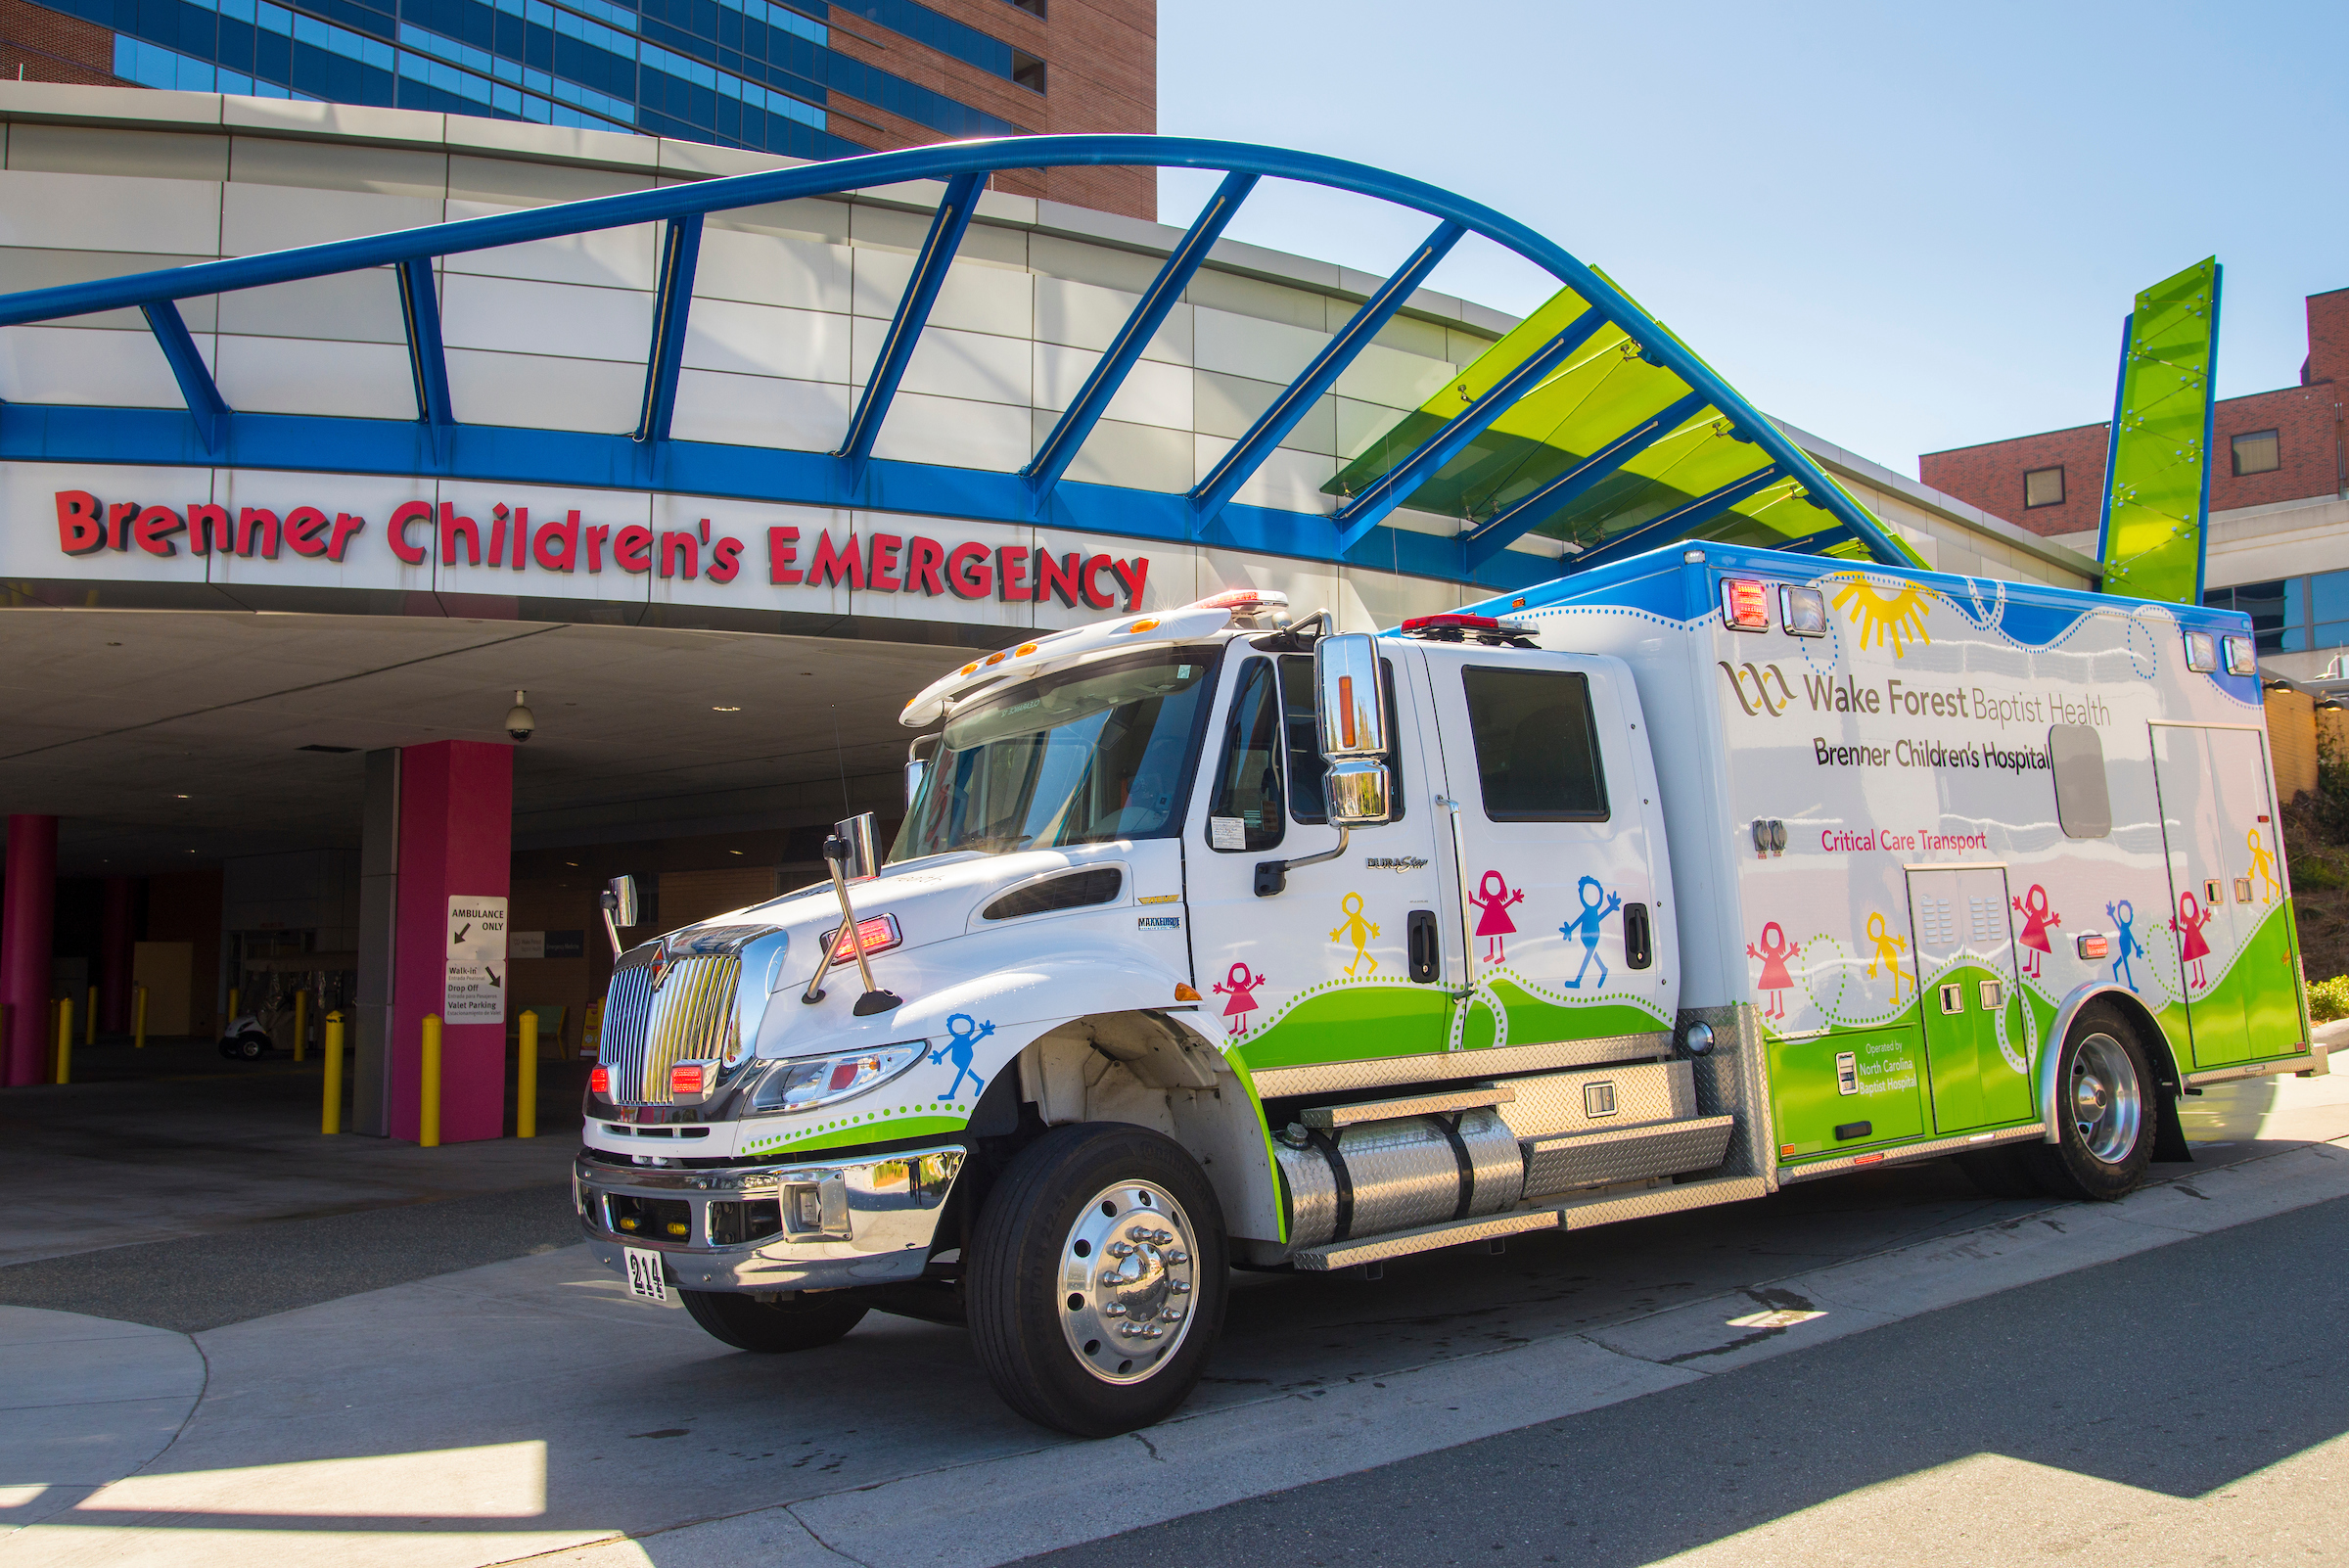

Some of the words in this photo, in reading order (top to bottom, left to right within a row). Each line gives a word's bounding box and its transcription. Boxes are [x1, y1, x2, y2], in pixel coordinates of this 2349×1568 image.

[55, 489, 366, 564] Brenner
[387, 501, 745, 585] Children's
[767, 526, 1151, 612] EMERGENCY
[1803, 673, 1880, 715] Wake
[1888, 679, 1969, 717] Forest
[1972, 687, 2045, 729] Baptist
[2049, 692, 2111, 726] Health
[1813, 736, 1891, 766] Brenner
[1895, 739, 1980, 768] Children's
[1982, 741, 2051, 775] Hospital
[1821, 828, 1876, 853] Critical
[1880, 829, 1915, 852] Care
[1917, 829, 1988, 856] Transport
[452, 909, 504, 918] AMBULANCE
[468, 1001, 497, 1010] Parking
[1865, 1040, 1895, 1057] Operated
[1895, 1039, 1903, 1053] by
[1860, 1060, 1882, 1077] North
[1883, 1057, 1913, 1073] Carolina
[1860, 1080, 1887, 1097] Baptist
[1887, 1074, 1917, 1092] Hospital
[629, 1254, 665, 1300] 214
